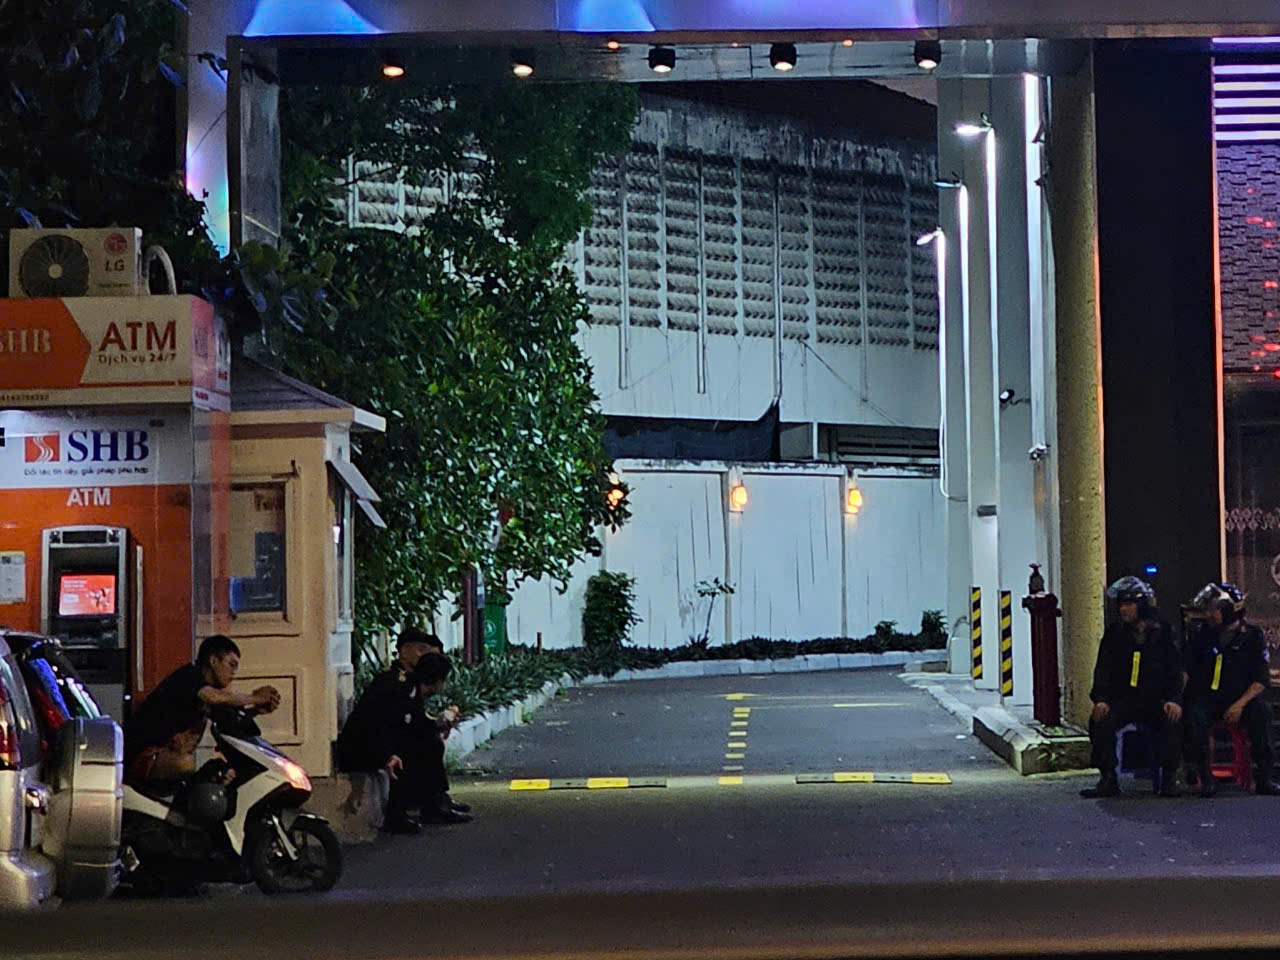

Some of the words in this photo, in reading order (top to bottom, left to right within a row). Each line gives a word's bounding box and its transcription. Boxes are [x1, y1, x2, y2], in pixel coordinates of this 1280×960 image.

[104, 259, 125, 272] LG
[99, 320, 177, 352] ATM
[150, 352, 177, 363] 24/7
[67, 429, 149, 462] SHB
[66, 487, 111, 506] ATM
